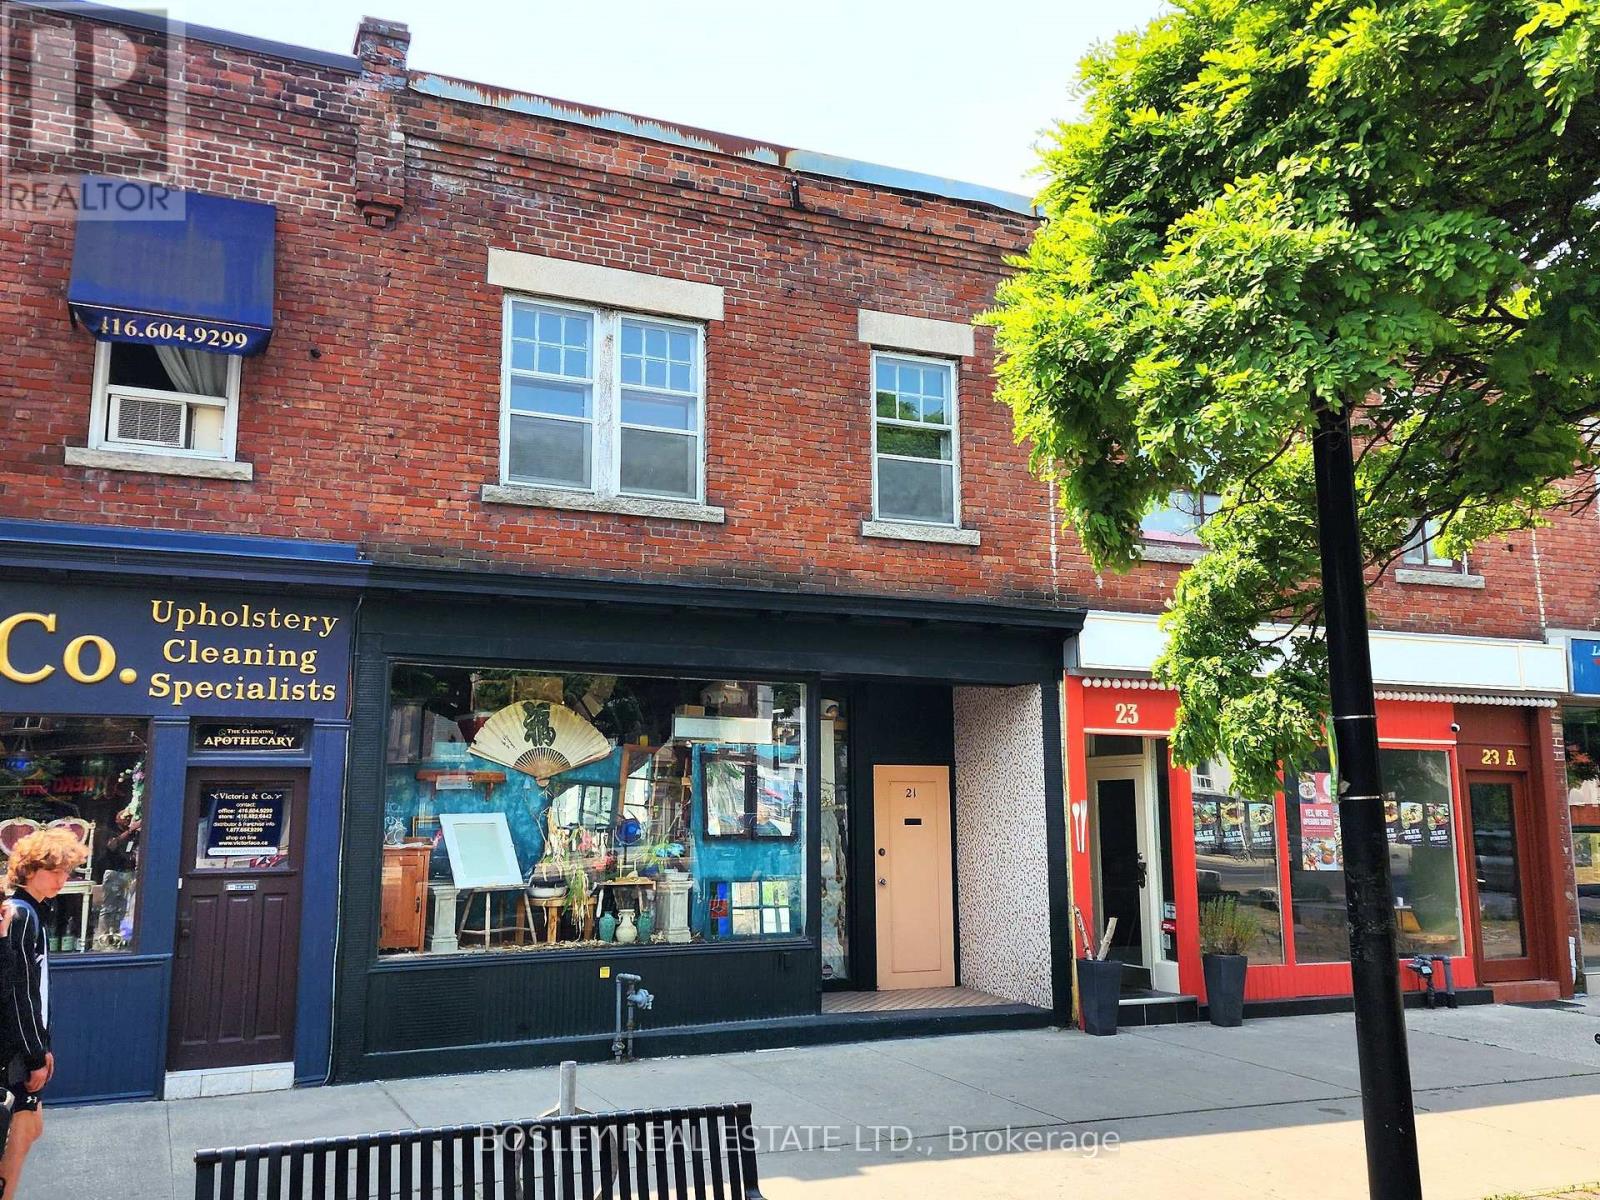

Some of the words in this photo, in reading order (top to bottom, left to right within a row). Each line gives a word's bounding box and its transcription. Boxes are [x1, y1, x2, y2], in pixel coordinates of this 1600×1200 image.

[151, 599, 340, 638] Upholstery
[0, 611, 138, 685] Co.
[163, 638, 318, 674] Cleaning
[149, 672, 337, 705] Specialists
[1115, 703, 1139, 724] 23
[203, 736, 295, 747] APOTHECARY
[1481, 749, 1500, 765] 23
[1506, 749, 1517, 766] A
[219, 792, 249, 800] Victoria
[260, 792, 274, 800] Co.
[905, 788, 917, 799] 21
